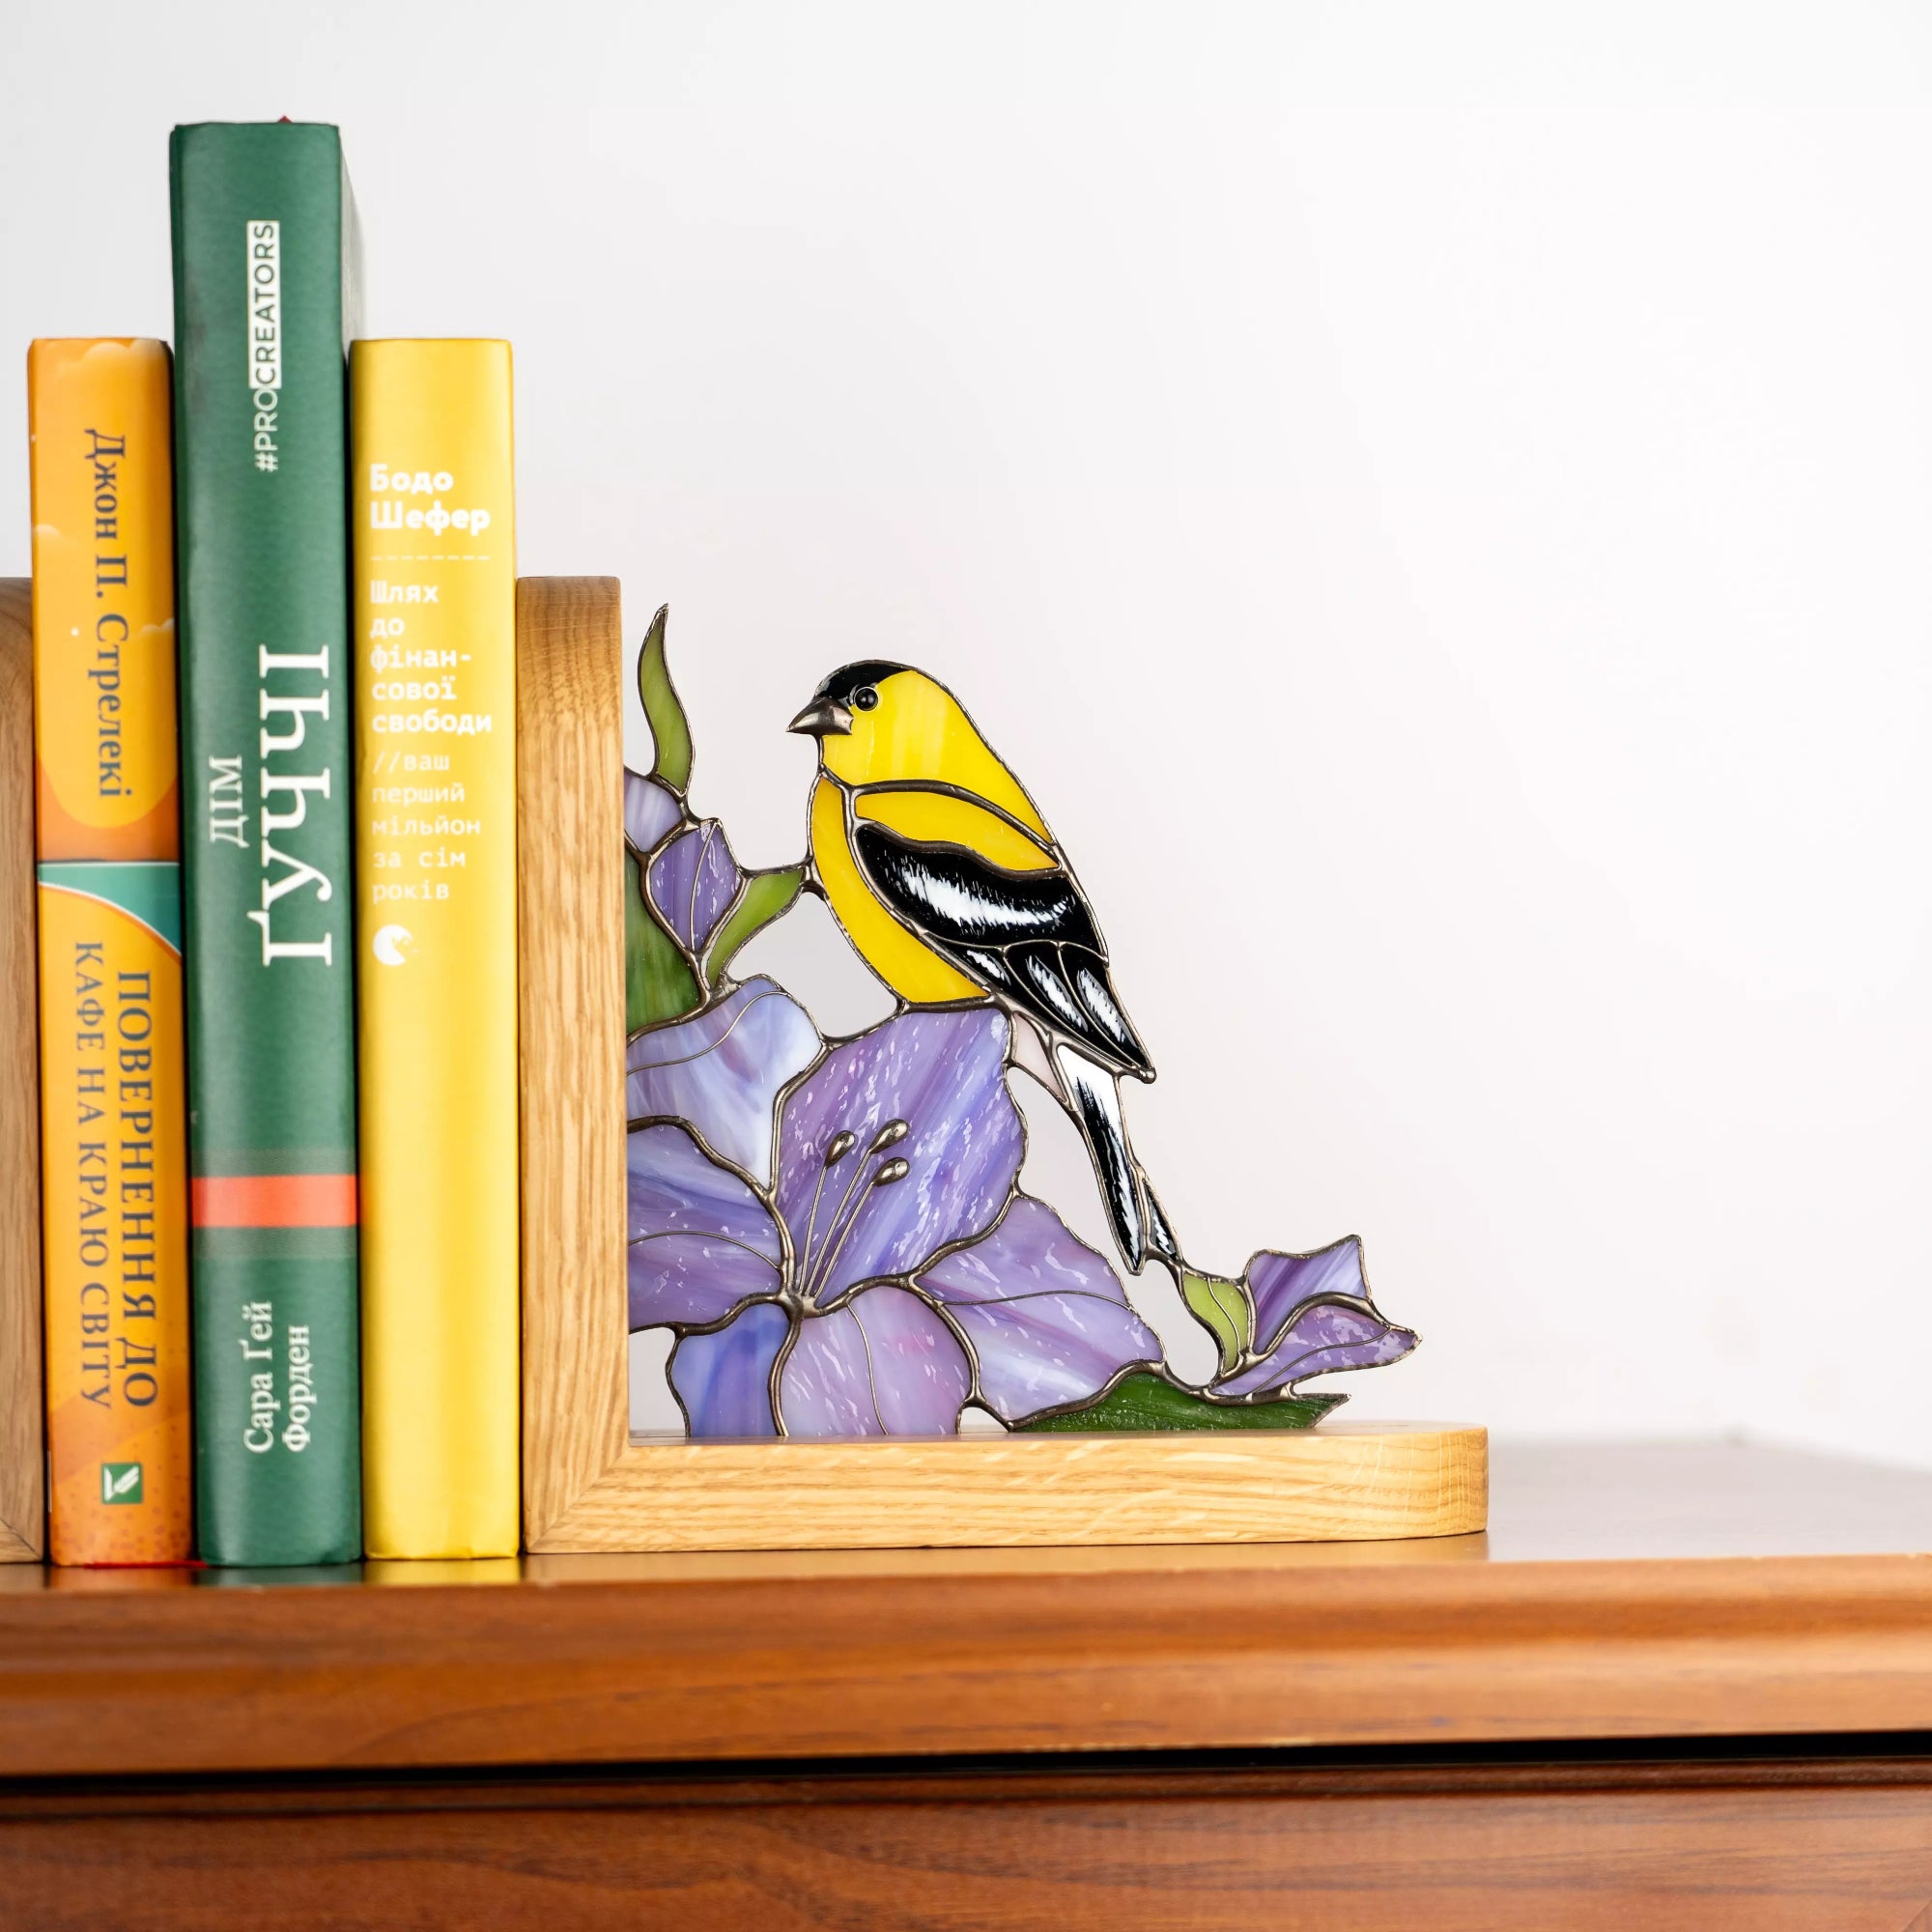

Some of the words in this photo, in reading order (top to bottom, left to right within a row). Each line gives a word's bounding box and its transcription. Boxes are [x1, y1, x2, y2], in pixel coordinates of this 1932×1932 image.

[253, 222, 279, 472] #PROCREATORS
[85, 429, 127, 540] Джон
[370, 464, 454, 495] Бодо
[370, 500, 491, 536] Шефер
[95, 554, 128, 600] П.
[370, 580, 439, 605] Шлях
[370, 617, 406, 639] до
[370, 644, 472, 674] фінан-
[371, 676, 458, 701] сової
[88, 613, 132, 798] Стрелекі
[372, 709, 493, 736] свободи
[209, 754, 250, 848] ДІМ
[372, 782, 466, 809] перший
[372, 815, 481, 836] мільйон
[373, 850, 402, 868] за
[418, 847, 467, 867] сім
[372, 881, 449, 904] років
[75, 941, 105, 1050] КАФЕ
[76, 1065, 106, 1125] НА
[118, 971, 156, 1321] ПОВЕРНЕННЯ
[78, 1142, 109, 1269] КРАЮ
[81, 1281, 112, 1409] СВІТУ
[238, 1301, 274, 1361] Ґей
[118, 1337, 159, 1408] ДО
[282, 1325, 317, 1453] Форден
[243, 1372, 280, 1455] Сара
